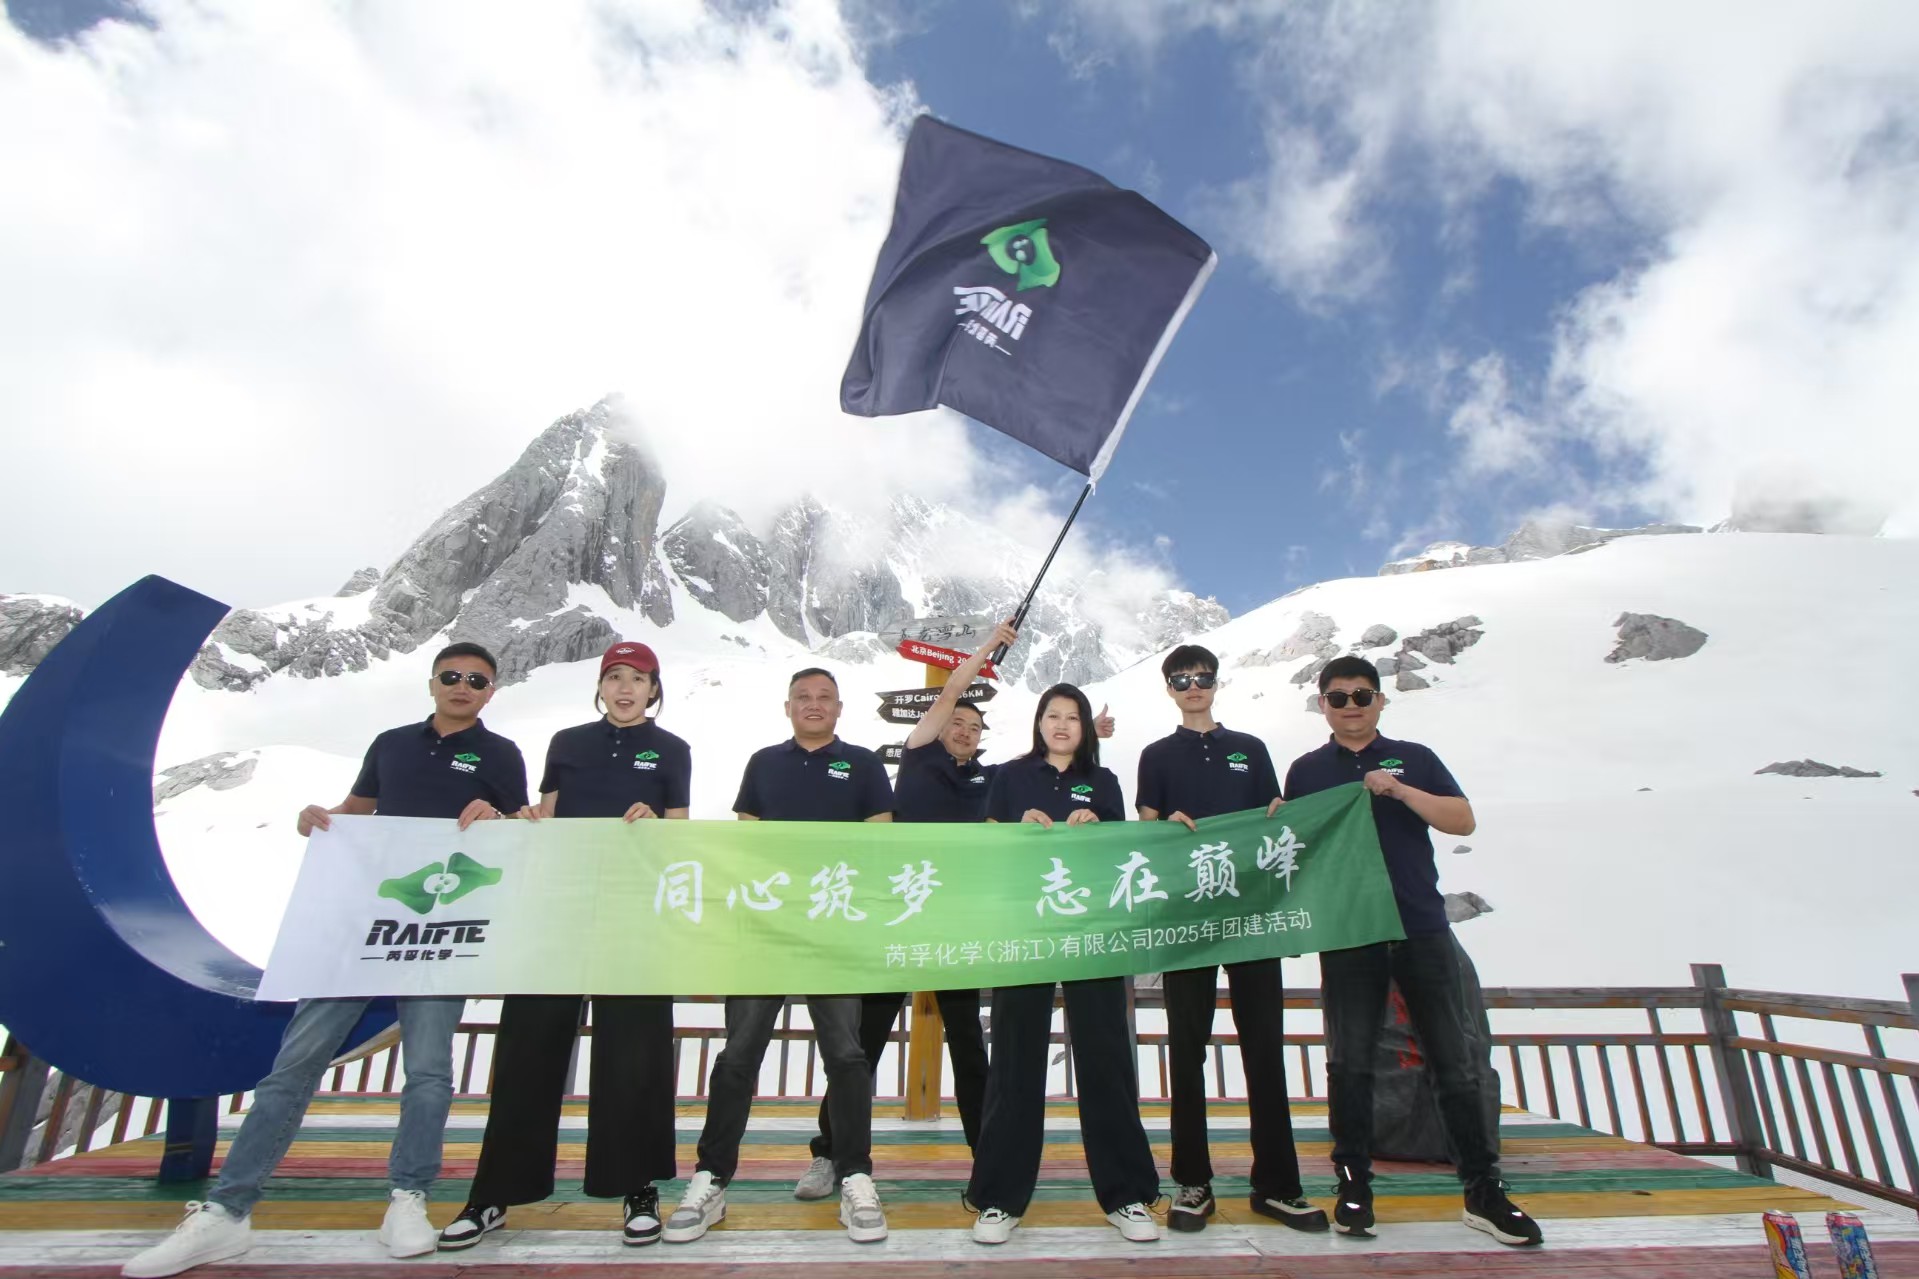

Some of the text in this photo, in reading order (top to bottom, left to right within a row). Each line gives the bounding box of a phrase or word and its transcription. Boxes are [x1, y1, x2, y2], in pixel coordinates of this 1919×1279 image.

[653, 825, 1306, 926] 同心筑梦 志在巅峰
